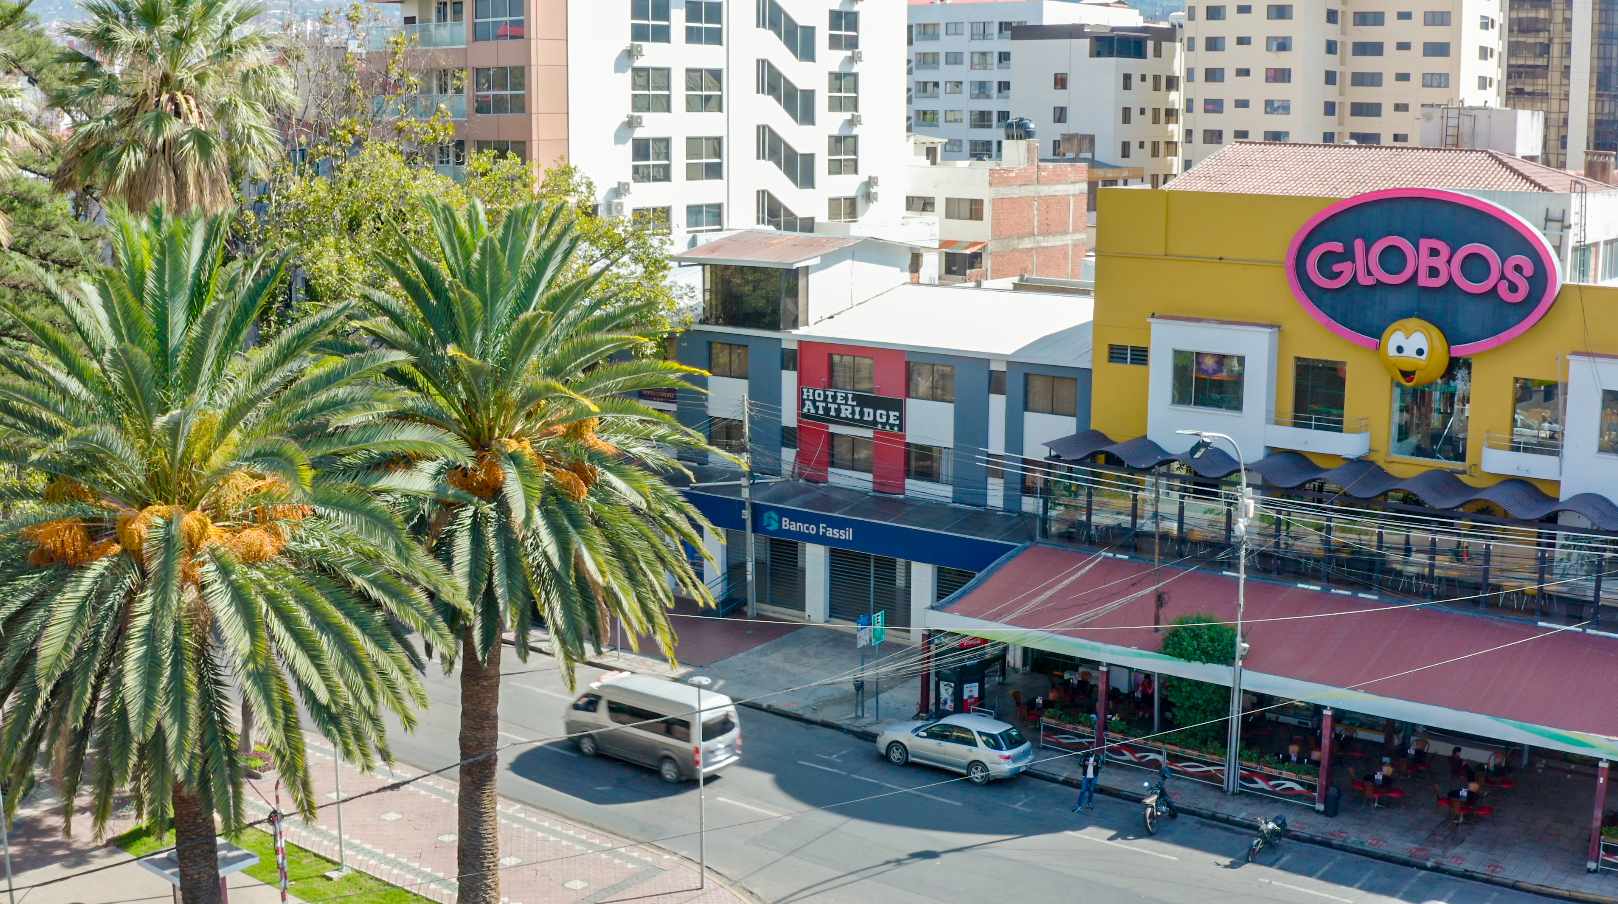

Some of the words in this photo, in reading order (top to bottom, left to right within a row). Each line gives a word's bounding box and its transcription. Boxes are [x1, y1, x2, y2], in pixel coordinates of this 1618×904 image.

[1306, 235, 1535, 304] GLOBOS
[802, 388, 857, 406] HOTEL
[802, 400, 900, 425] ATTRIDGE
[781, 516, 817, 535] Banco
[819, 523, 853, 541] Fassil
